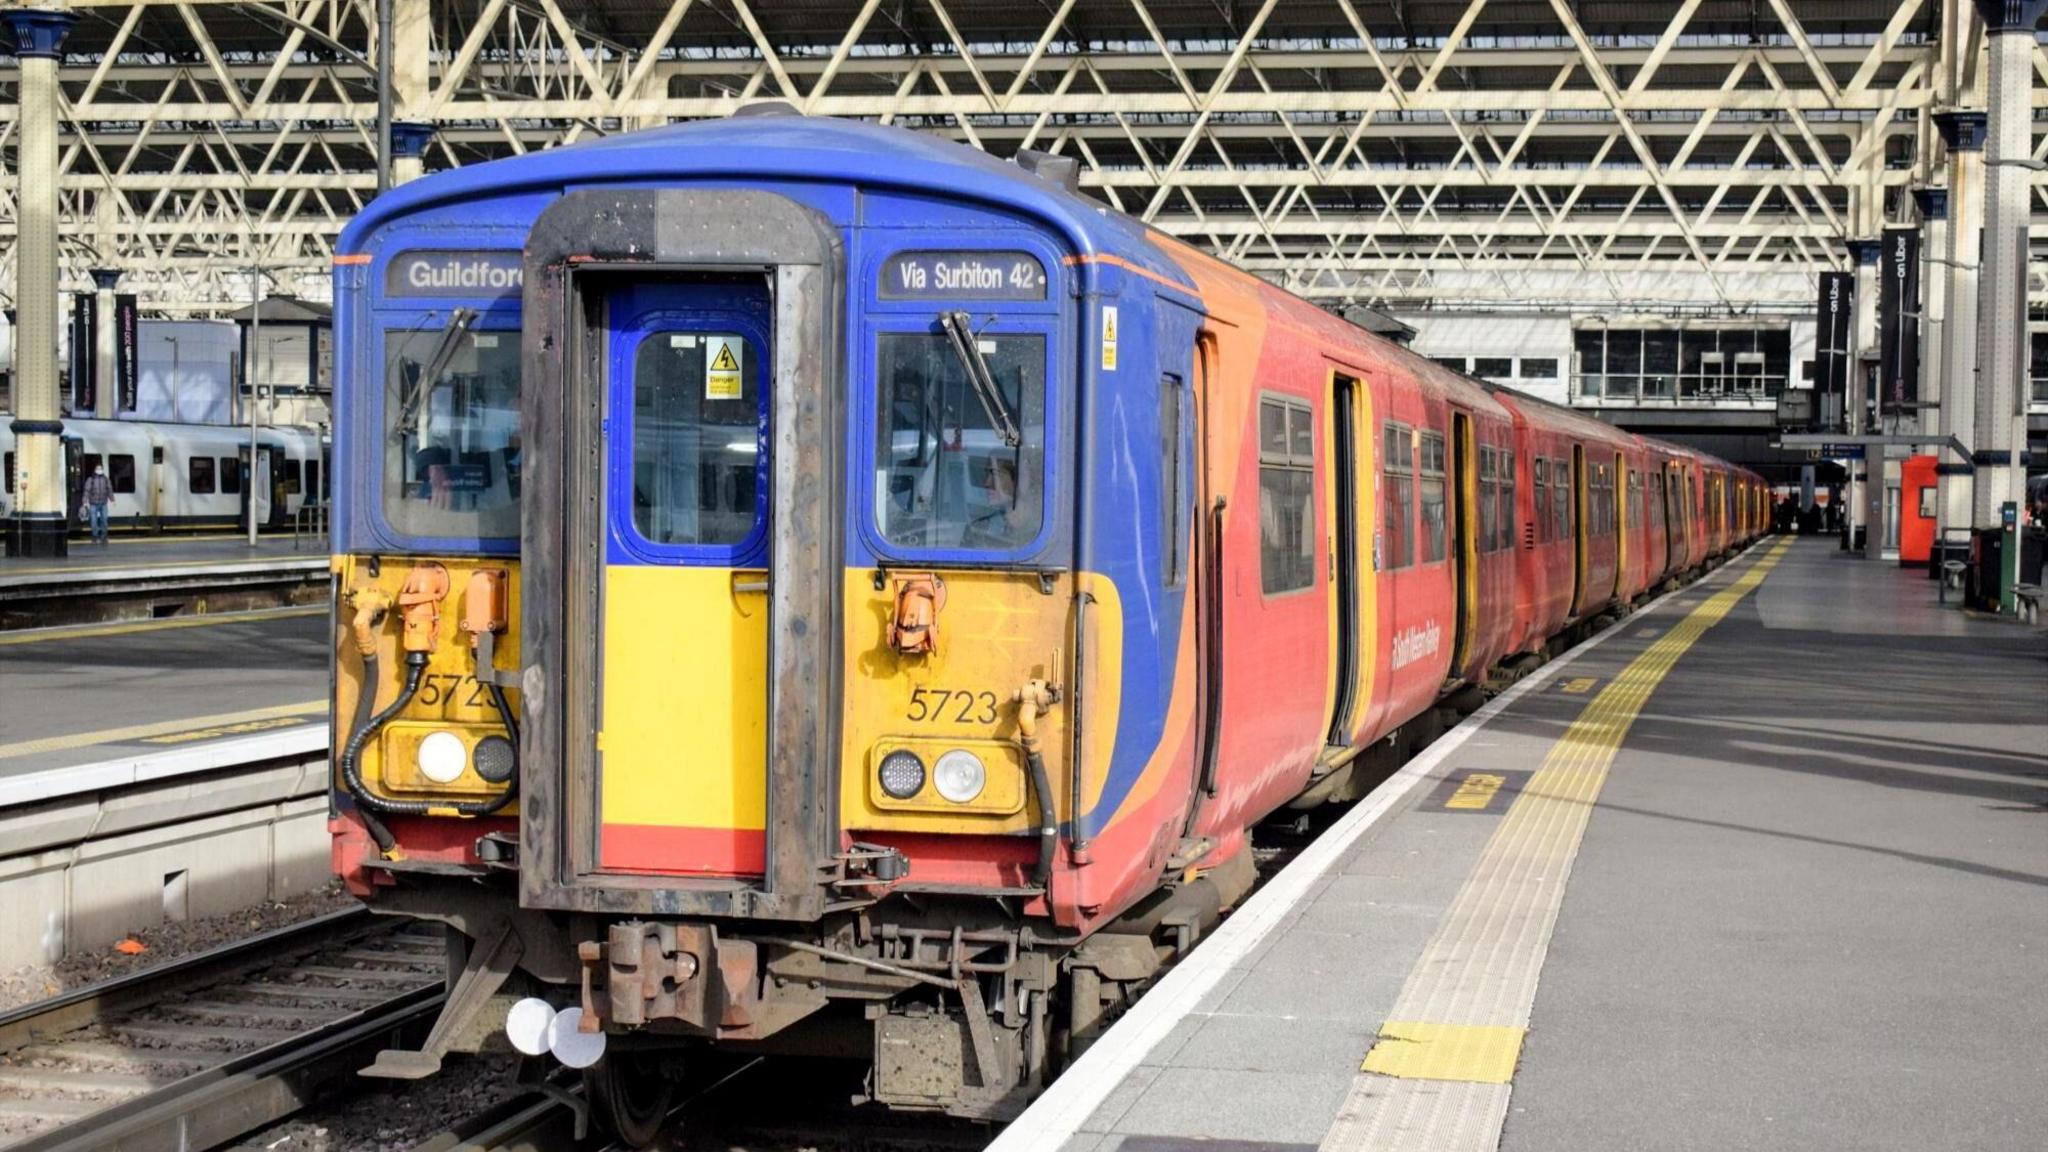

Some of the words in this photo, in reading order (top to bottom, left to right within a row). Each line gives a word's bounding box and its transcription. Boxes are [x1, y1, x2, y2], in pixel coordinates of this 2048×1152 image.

[1895, 235, 1906, 262] Uber
[900, 261, 927, 289] Via
[934, 262, 1002, 289] Surbiton
[1009, 262, 1034, 289] 42
[1896, 263, 1906, 278] on
[1829, 277, 1839, 300] Uber
[907, 689, 998, 724] 5723
